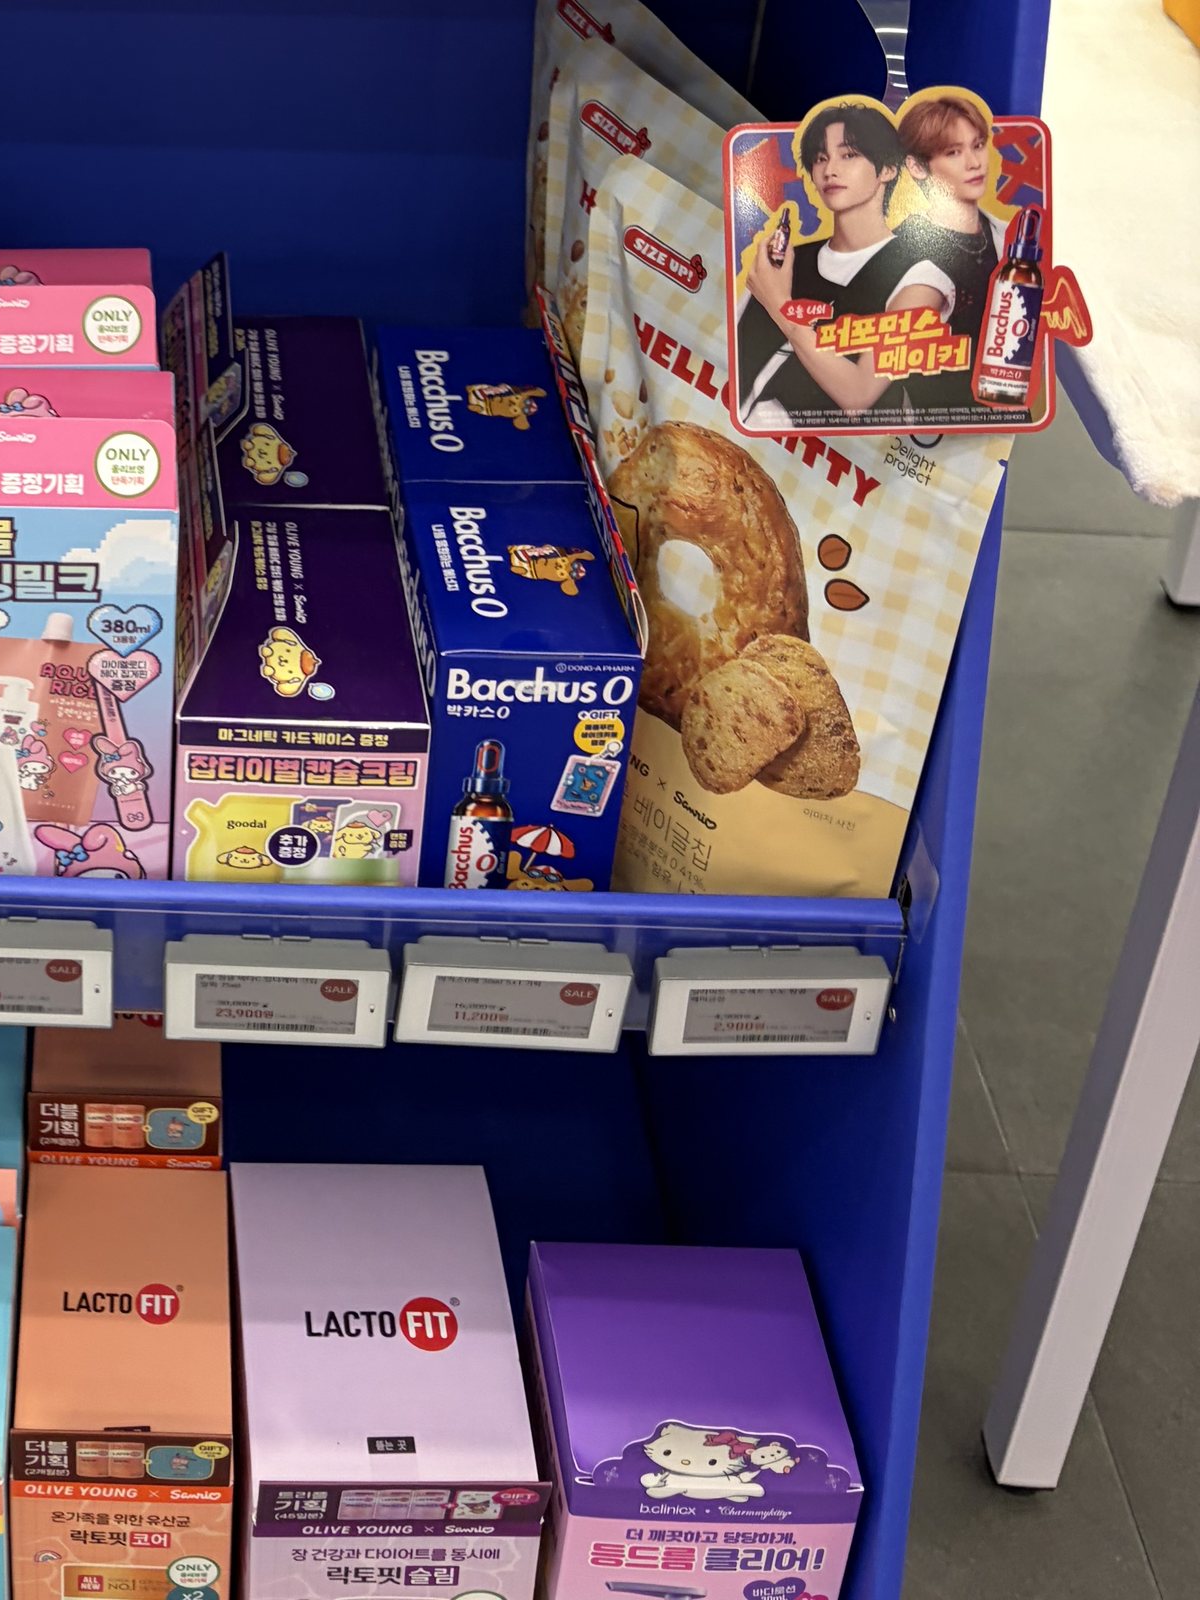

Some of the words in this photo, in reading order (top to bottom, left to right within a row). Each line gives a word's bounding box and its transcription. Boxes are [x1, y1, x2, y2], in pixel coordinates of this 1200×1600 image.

[590, 110, 618, 138] SIZE
[616, 133, 637, 151] UP!
[632, 236, 668, 267] SIZE
[669, 259, 694, 283] UP!
[92, 310, 133, 322] ONLY
[786, 305, 804, 318] 오늘
[819, 309, 944, 348] 퍼포먼스
[986, 291, 1013, 358] Bacchus
[633, 312, 731, 411] HELL
[878, 338, 968, 371] 메이커
[415, 350, 463, 432] Bacchus
[105, 448, 150, 461] ONLY
[890, 436, 937, 473] Delight
[111, 464, 145, 475] 올리브영
[883, 451, 932, 487] project
[0, 473, 84, 495] 증정기획
[285, 522, 300, 547] OLIVE
[449, 506, 503, 595] Bacchus
[288, 549, 304, 579] YOUNG
[293, 594, 307, 624] Sanrio
[100, 617, 151, 634] 380ml
[111, 680, 136, 691] 증정
[447, 667, 598, 703] Bacchus
[218, 727, 278, 744] 마그네틱
[281, 730, 356, 747] 카드케이스
[359, 733, 389, 747] 증정
[304, 759, 417, 787] 캡슐크림
[673, 790, 717, 830] Sanrio
[226, 818, 267, 830] goodal
[278, 834, 308, 847] 추가
[633, 797, 712, 871] 베이글칩
[278, 846, 308, 859] 증정
[450, 826, 474, 889] Bacchus
[49, 964, 80, 976] SALE
[324, 985, 354, 994] SALE
[564, 989, 594, 998] SALE
[820, 994, 851, 1004] SALE
[40, 1103, 80, 1118] 더블
[40, 1120, 79, 1137] 기획
[39, 1154, 82, 1164] OLIVE
[87, 1156, 140, 1167] YOUNG
[166, 1158, 212, 1169] Sanrio
[63, 1291, 132, 1313] LACTO
[140, 1293, 176, 1317] FIT
[305, 1311, 397, 1338] LACTO
[406, 1312, 450, 1339] FIT
[25, 1440, 69, 1455] 더블
[25, 1454, 69, 1469] 기획
[24, 1485, 74, 1497] OLIVE
[80, 1486, 138, 1499] YOUNG
[170, 1489, 221, 1500] Sanrio
[275, 1500, 327, 1512] 기획
[51, 1511, 110, 1525] 온가족을
[113, 1512, 144, 1526] 위한
[147, 1515, 190, 1528] 유산균
[70, 1530, 127, 1547] 락토핏
[132, 1533, 169, 1547] 코어
[302, 1525, 350, 1535] OLIVE
[356, 1525, 413, 1535] YOUNG
[444, 1525, 494, 1535] Sanrio
[625, 1528, 643, 1541] 더
[650, 1529, 718, 1544] 깨끗하고
[291, 1549, 308, 1562] 장
[311, 1549, 361, 1561] 건강과
[365, 1549, 446, 1561] 다이어트를
[451, 1549, 500, 1561] 동시에
[589, 1542, 696, 1570] 등드름
[703, 1547, 825, 1571] 클리어!
[82, 1576, 98, 1584] ALL
[327, 1566, 401, 1585] 락토핏
[408, 1567, 455, 1585] 슬림
[80, 1583, 100, 1591] NEW
